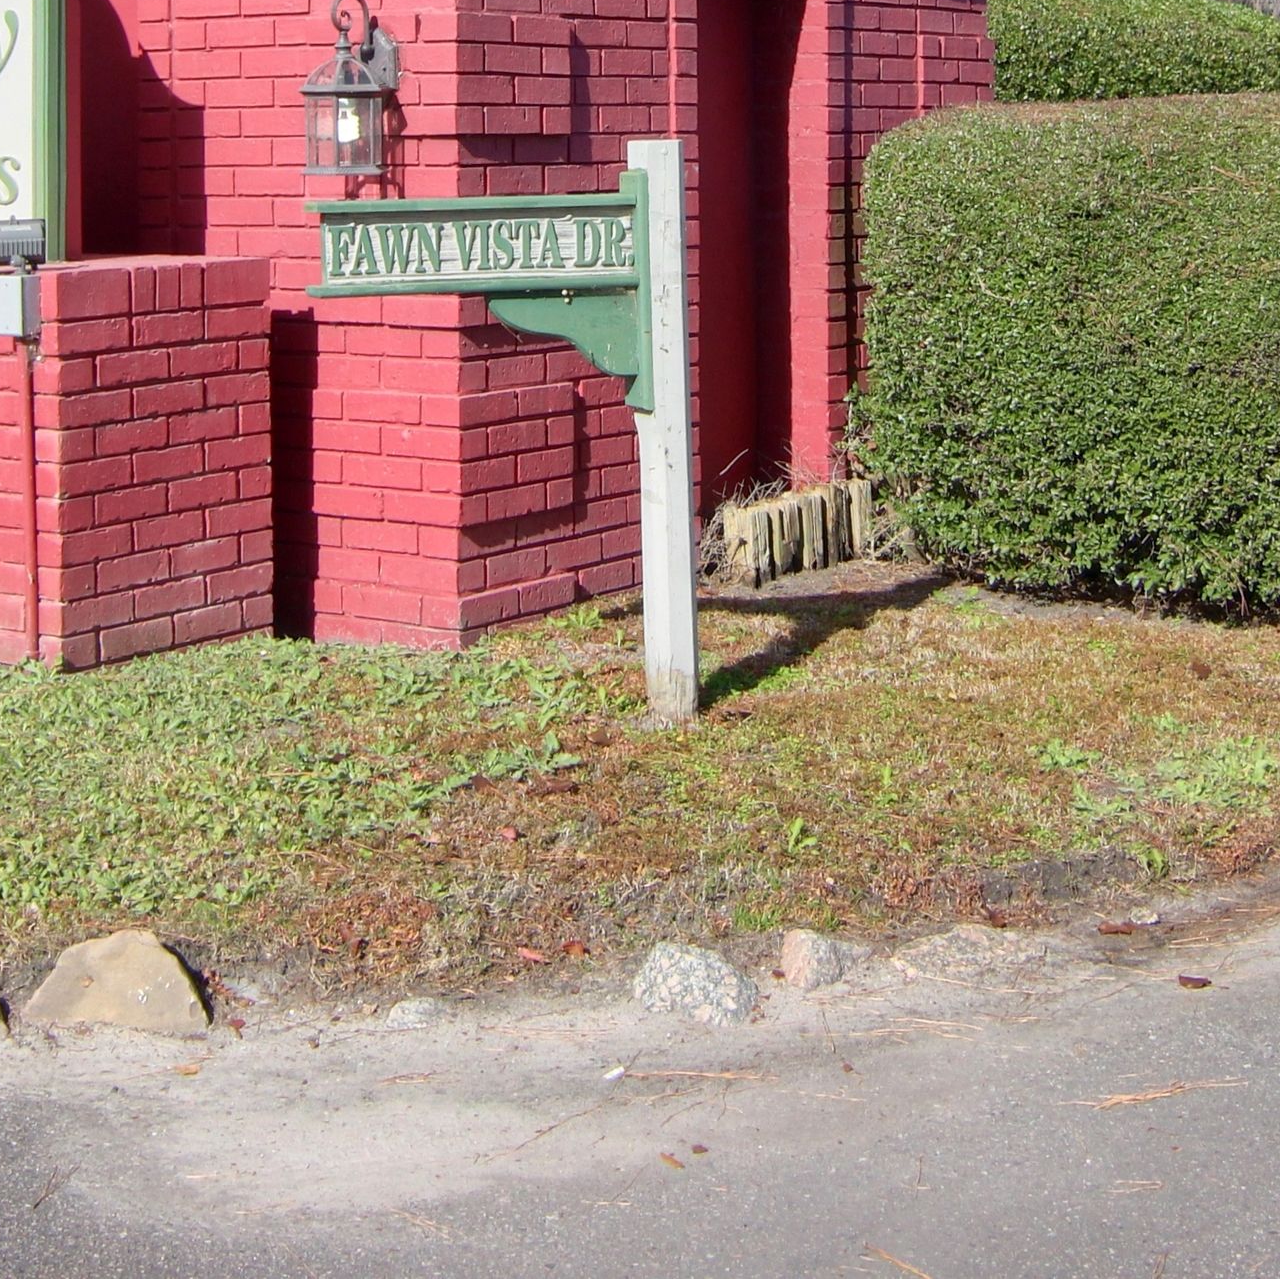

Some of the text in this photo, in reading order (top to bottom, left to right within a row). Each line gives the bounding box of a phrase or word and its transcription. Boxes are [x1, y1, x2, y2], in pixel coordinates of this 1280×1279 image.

[328, 217, 635, 277] FAWN VISTA DR.
